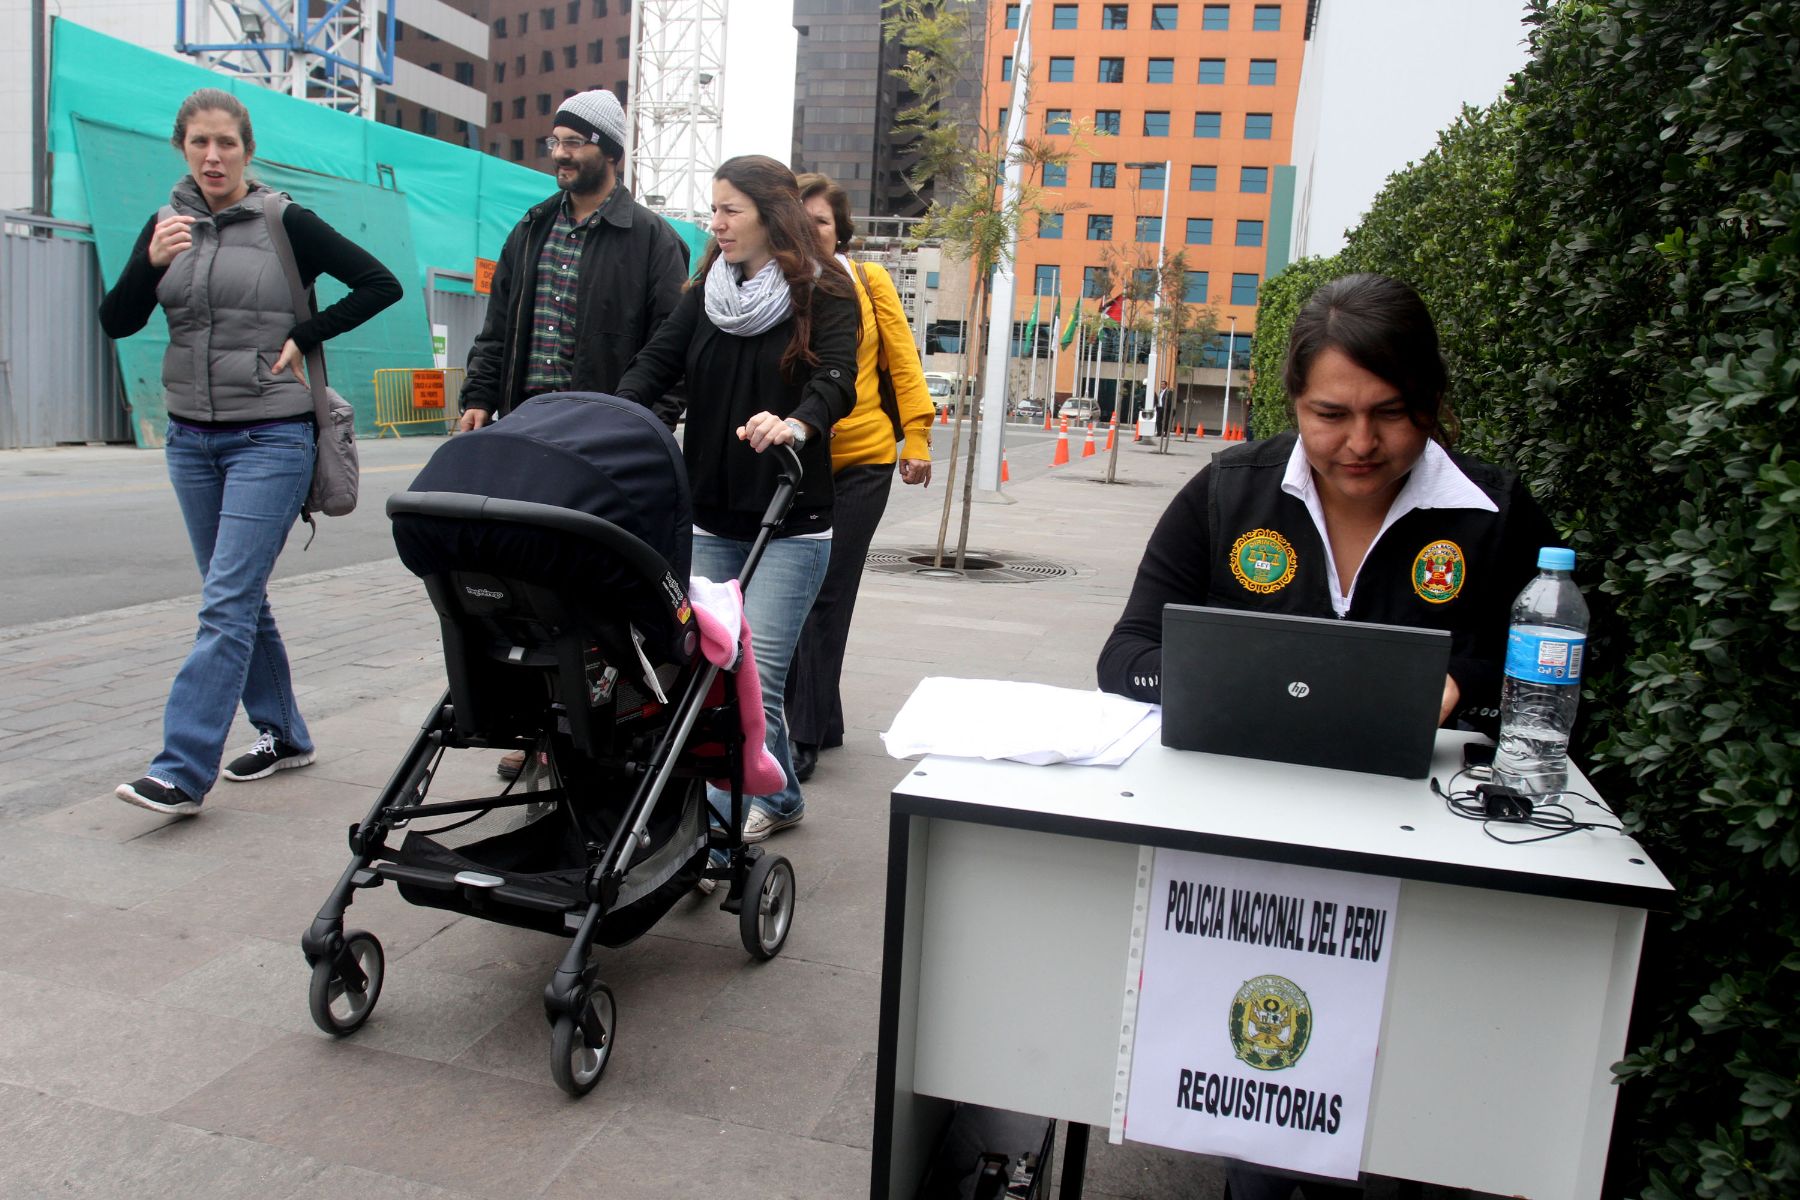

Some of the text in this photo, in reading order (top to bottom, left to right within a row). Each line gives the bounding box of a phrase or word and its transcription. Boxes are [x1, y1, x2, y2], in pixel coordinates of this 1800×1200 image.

[1256, 561, 1269, 569] LEY
[1291, 682, 1307, 697] hp
[1165, 880, 1387, 962] POLICIA NACIONAL DEL PERU
[1176, 1068, 1343, 1135] REQUISITORIAS
